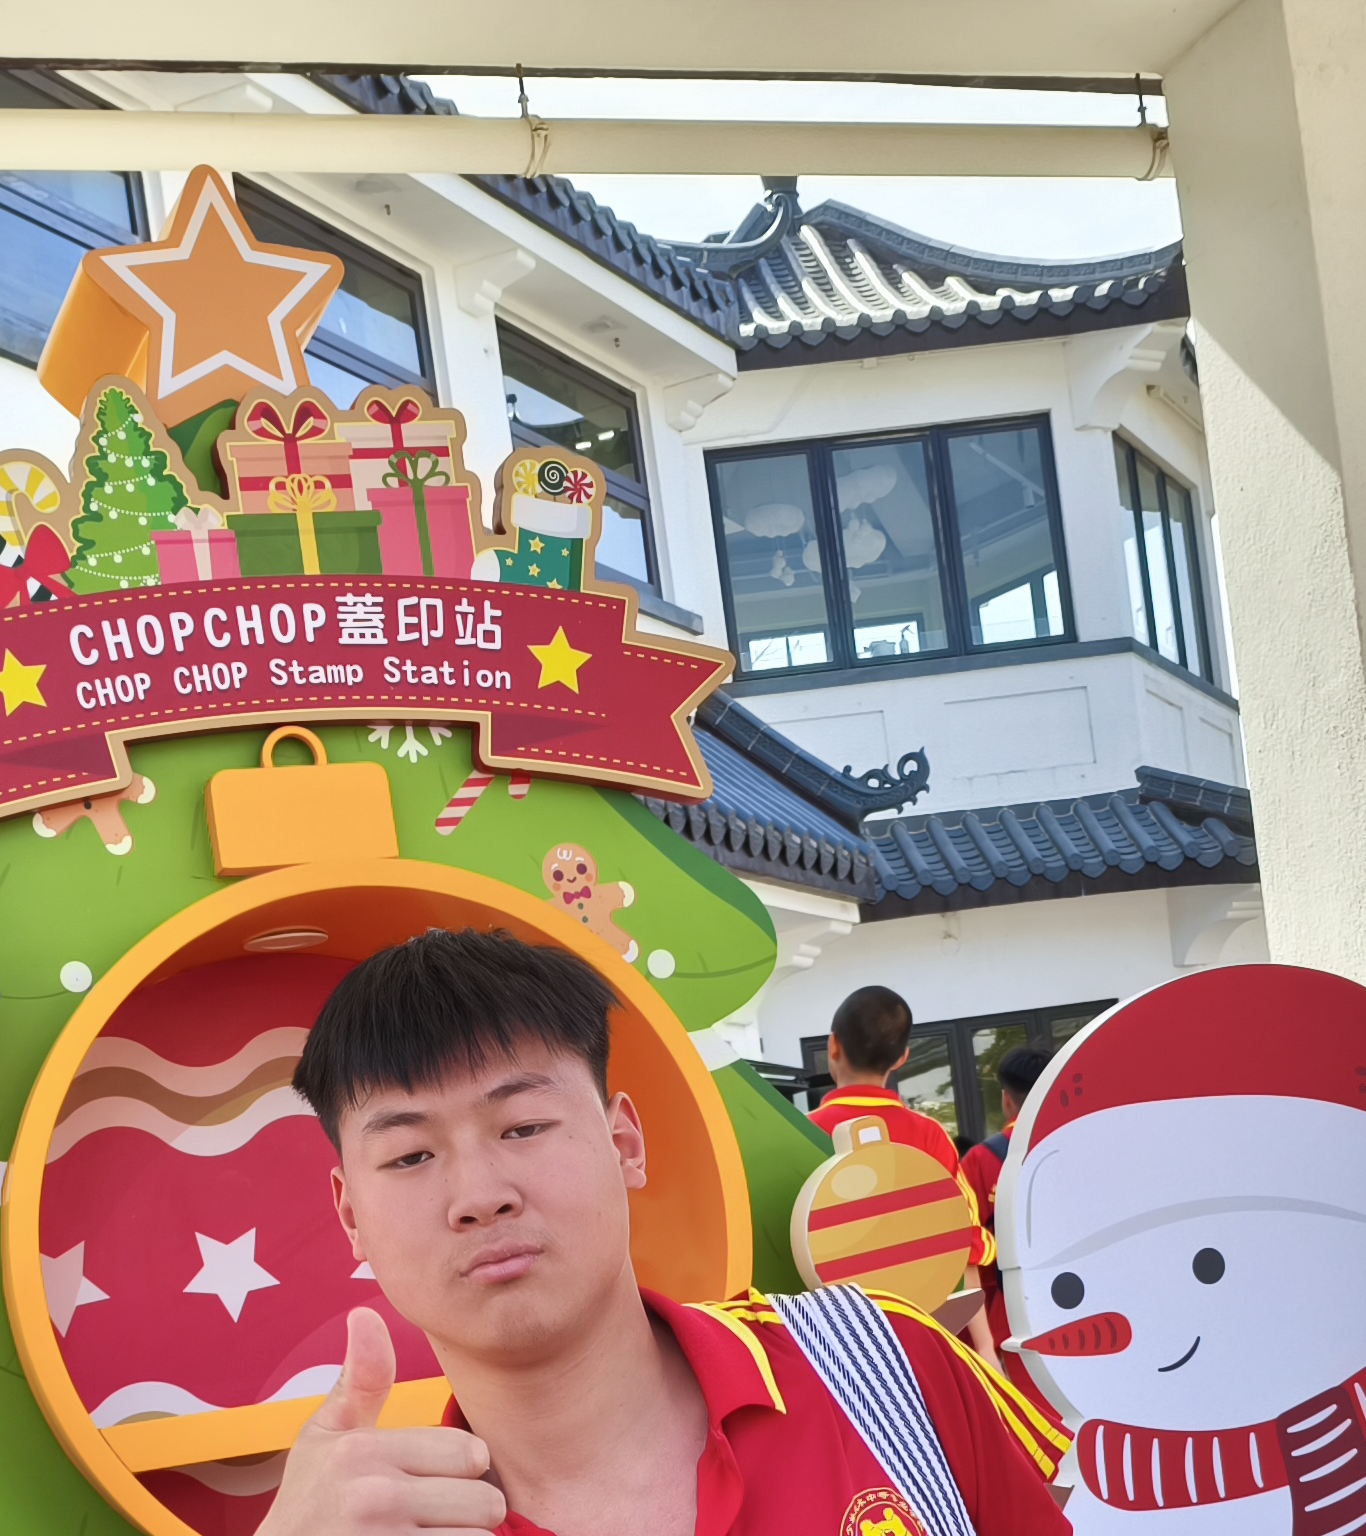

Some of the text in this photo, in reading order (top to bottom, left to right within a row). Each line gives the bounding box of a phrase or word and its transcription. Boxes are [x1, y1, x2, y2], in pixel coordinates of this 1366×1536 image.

[76, 656, 512, 709] CHOP CHOP Stamp Station
